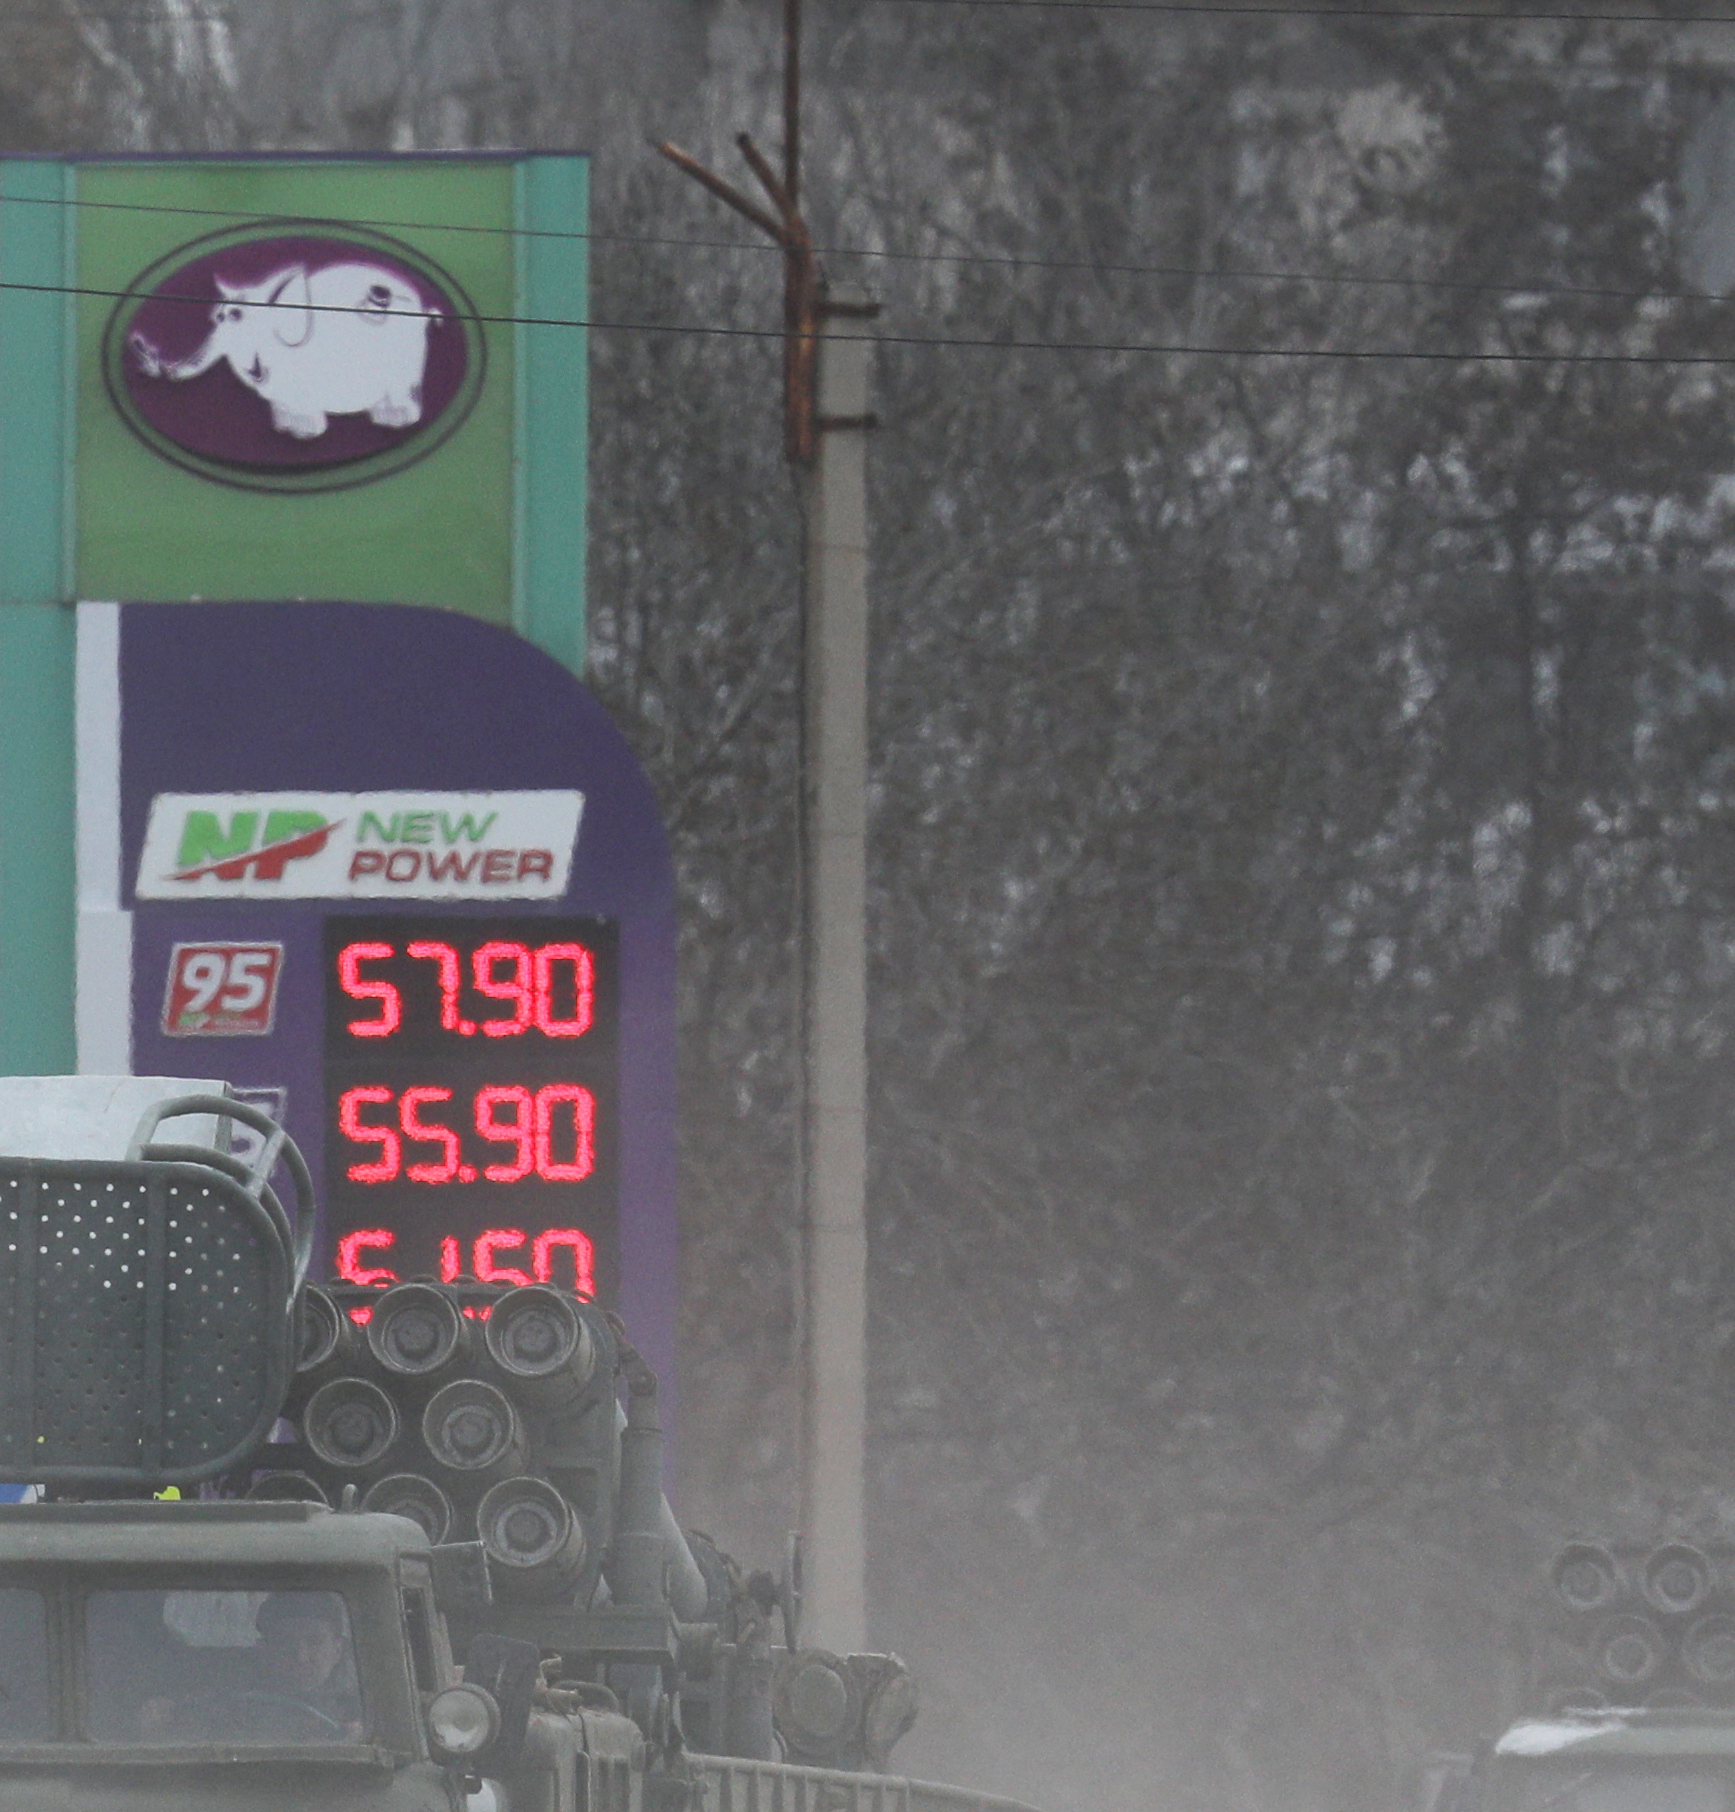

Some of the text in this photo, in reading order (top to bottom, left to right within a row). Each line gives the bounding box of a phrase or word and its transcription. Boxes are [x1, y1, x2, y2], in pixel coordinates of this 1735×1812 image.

[173, 810, 333, 881] NP
[356, 811, 497, 843] NEW
[348, 849, 553, 884] POWER
[182, 951, 271, 1012] 95
[338, 941, 594, 1037] 57.90
[338, 1083, 596, 1184] 55.90
